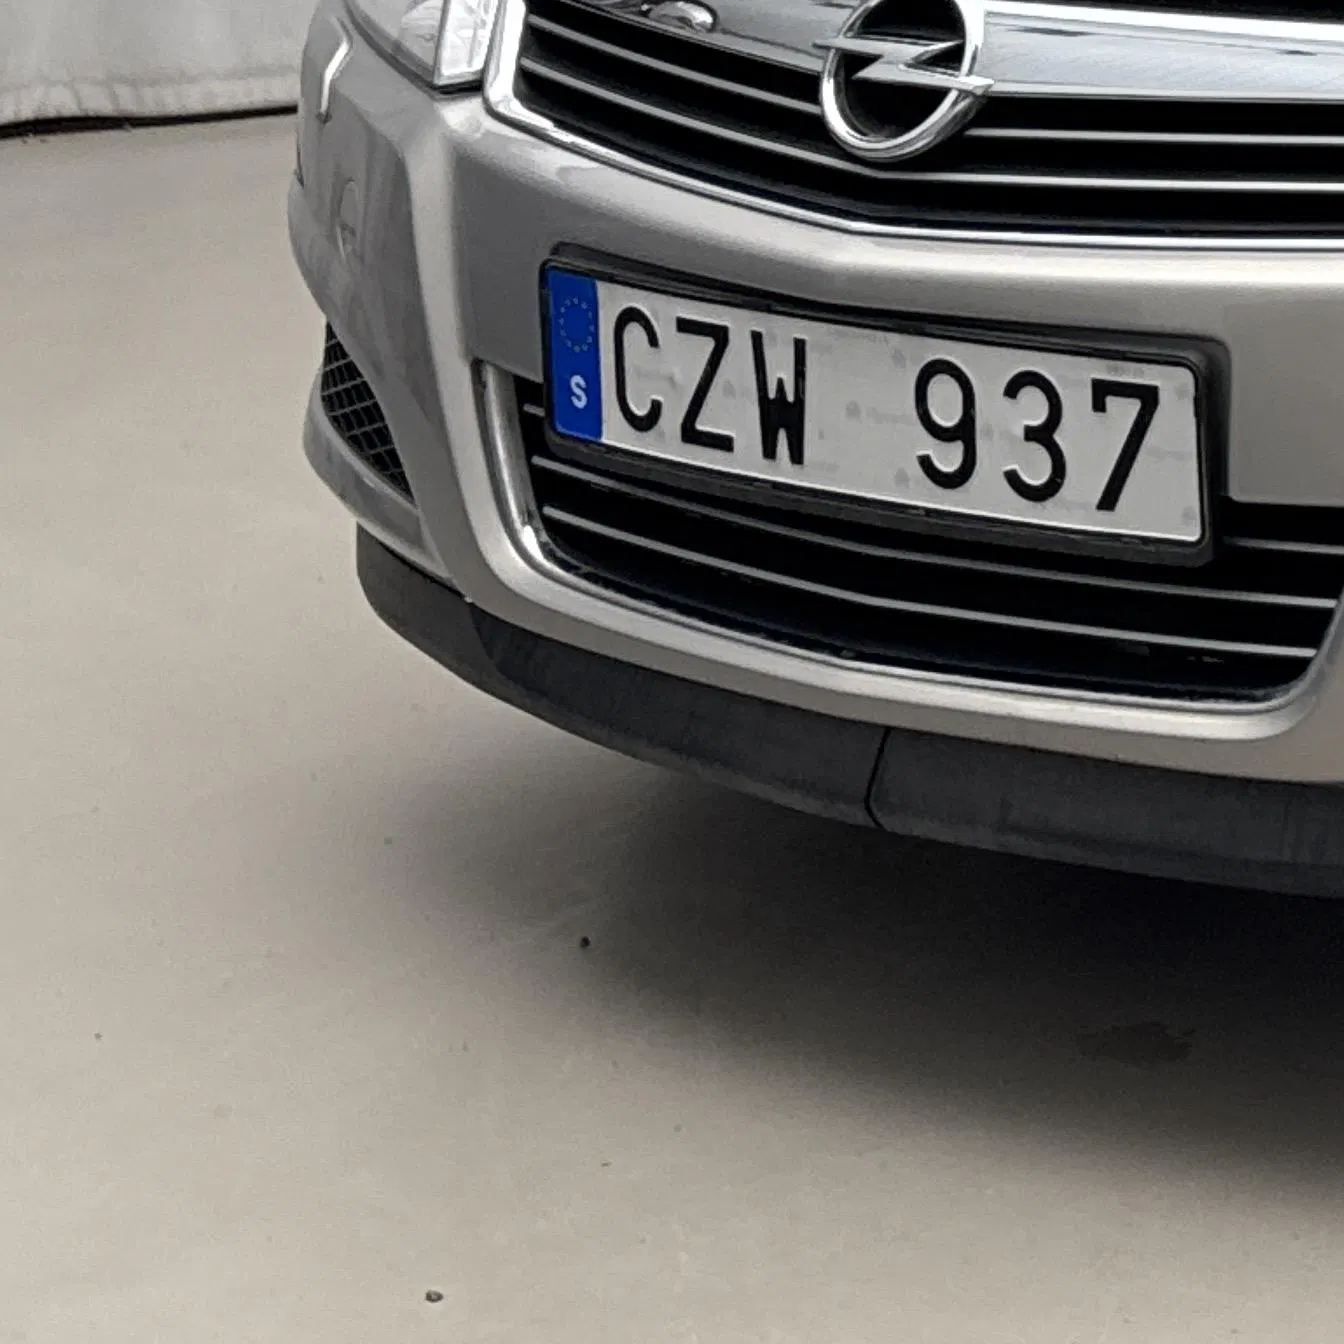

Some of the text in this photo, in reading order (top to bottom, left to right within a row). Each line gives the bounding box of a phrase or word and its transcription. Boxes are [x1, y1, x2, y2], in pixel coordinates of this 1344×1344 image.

[570, 375, 587, 409] S
[613, 306, 1161, 513] CZW 937
